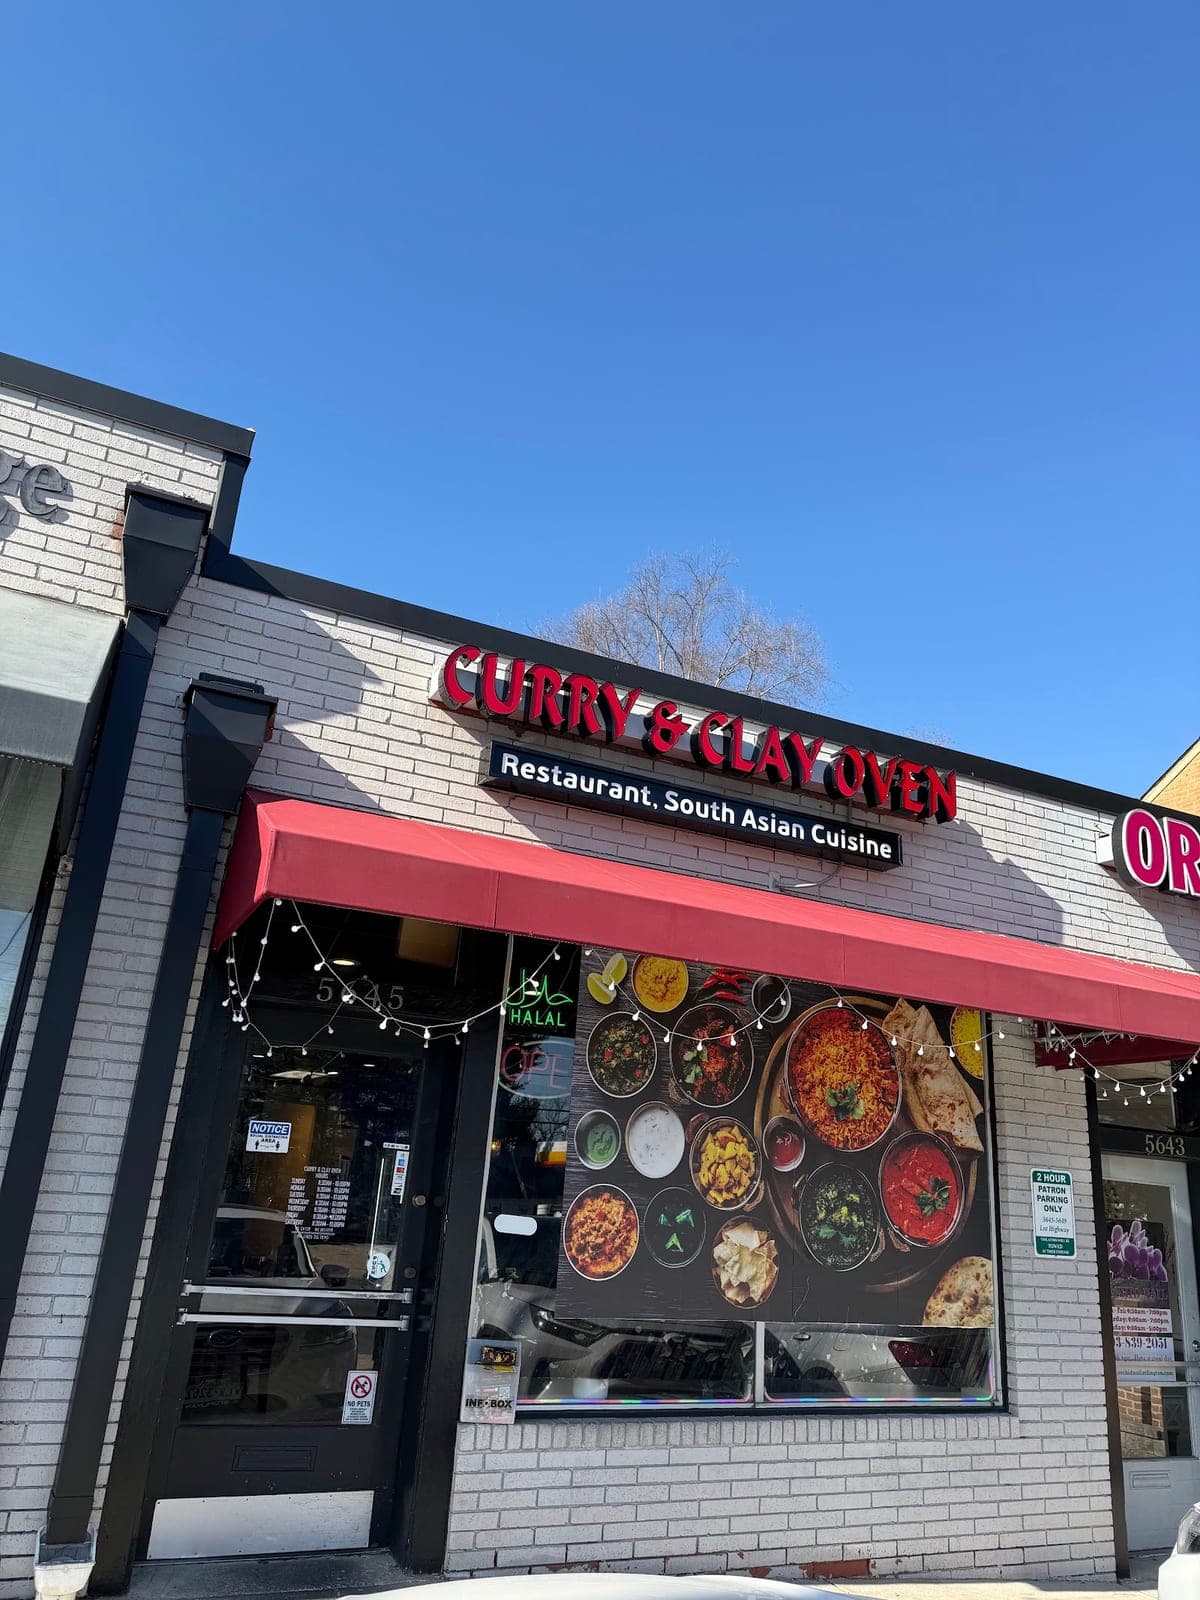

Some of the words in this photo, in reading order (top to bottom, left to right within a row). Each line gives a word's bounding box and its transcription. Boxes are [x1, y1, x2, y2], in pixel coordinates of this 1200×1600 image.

[443, 644, 644, 741] CURRY
[646, 700, 691, 754] &
[698, 711, 826, 785] CLAY
[832, 745, 957, 822] OVEN
[501, 752, 658, 810] Restaurant,
[664, 790, 735, 825] South
[741, 808, 805, 840] Asian
[811, 824, 892, 859] Cuisine
[511, 1008, 566, 1027] HALAL
[251, 1123, 289, 1134] NOTICE
[1144, 1134, 1185, 1156] 5643
[1036, 1172, 1042, 1181] 2
[1043, 1173, 1066, 1184] HOUR
[1038, 1185, 1066, 1194] PATRON
[1036, 1195, 1069, 1204] PARKING
[1043, 1204, 1063, 1213] ONLY
[357, 1400, 370, 1408] PETS
